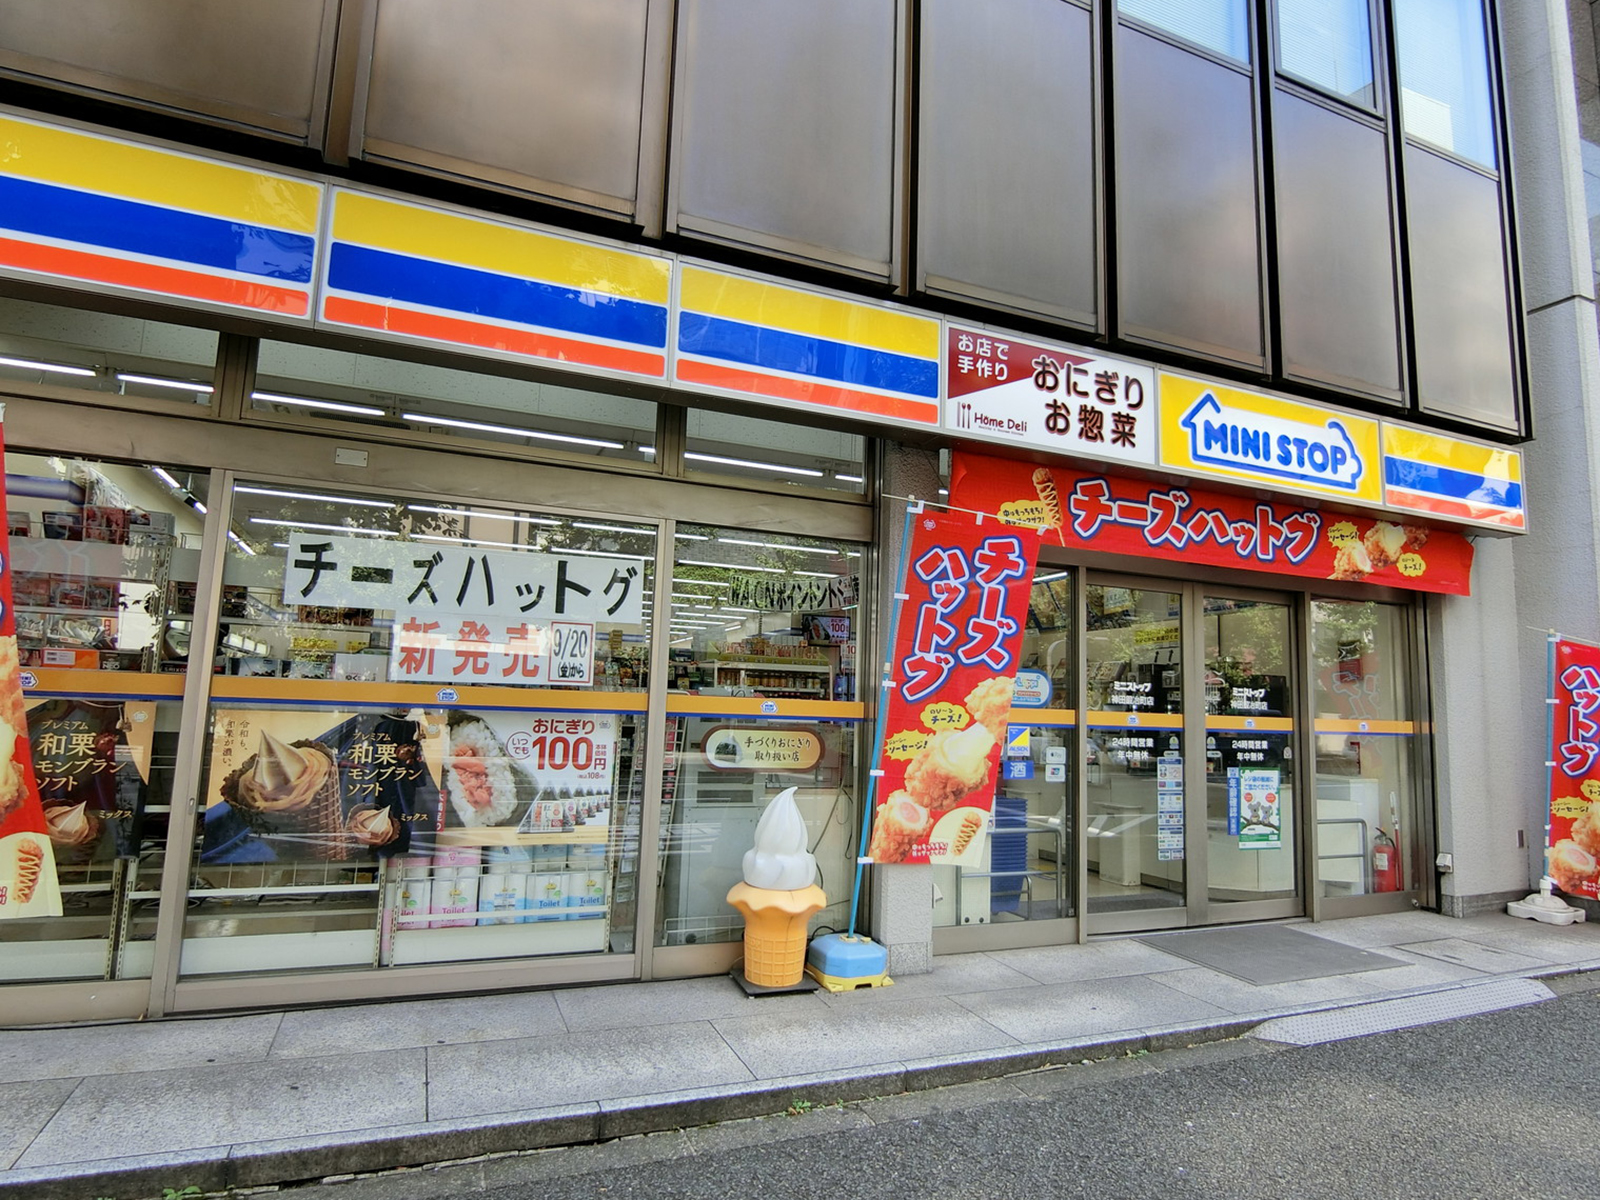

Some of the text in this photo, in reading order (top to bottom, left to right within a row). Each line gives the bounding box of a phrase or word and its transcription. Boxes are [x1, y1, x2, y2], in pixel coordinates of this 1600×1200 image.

[957, 334, 1010, 361] お店で
[957, 355, 1009, 381] 手作り
[1033, 356, 1145, 410] おにぎり
[1007, 418, 1027, 432] Deli
[1044, 399, 1137, 448] お惣菜
[1203, 419, 1347, 475] MINI STOP
[1072, 477, 1322, 564] チーズハットグ
[294, 541, 638, 616] チーズハットグ
[957, 537, 1024, 671] チーズ
[903, 548, 969, 701] ハットグ
[399, 617, 541, 677] 新発売
[553, 628, 588, 660] 9/20
[1114, 681, 1152, 692] ミニストップ
[41, 720, 89, 730] プレミアム
[532, 718, 595, 735] おにぎり
[931, 714, 962, 725] チーズ!
[353, 732, 391, 741] プレミアム
[512, 738, 529, 746] いつ
[744, 736, 812, 749] 手づくりおにぎり
[1112, 737, 1154, 748] 24時間営業
[37, 732, 97, 756] 和栗
[513, 746, 529, 755] でも
[889, 741, 928, 754] ソーセージ!
[1231, 740, 1269, 750] 24時間営業
[350, 743, 398, 764] 和栗
[532, 736, 594, 770] 100
[754, 750, 801, 762] 取り扱い店
[1117, 750, 1149, 760] 年中無休
[1236, 752, 1265, 761] 年中無休
[35, 759, 127, 774] モンブラン
[594, 758, 607, 770] 円
[1010, 761, 1027, 778] 酒
[348, 768, 423, 781] モンブラン
[36, 775, 78, 791] ソフト
[347, 783, 383, 797] ソフト
[99, 808, 133, 820] ミックス
[400, 812, 428, 821] ミックス
[580, 896, 600, 905] Toilet
